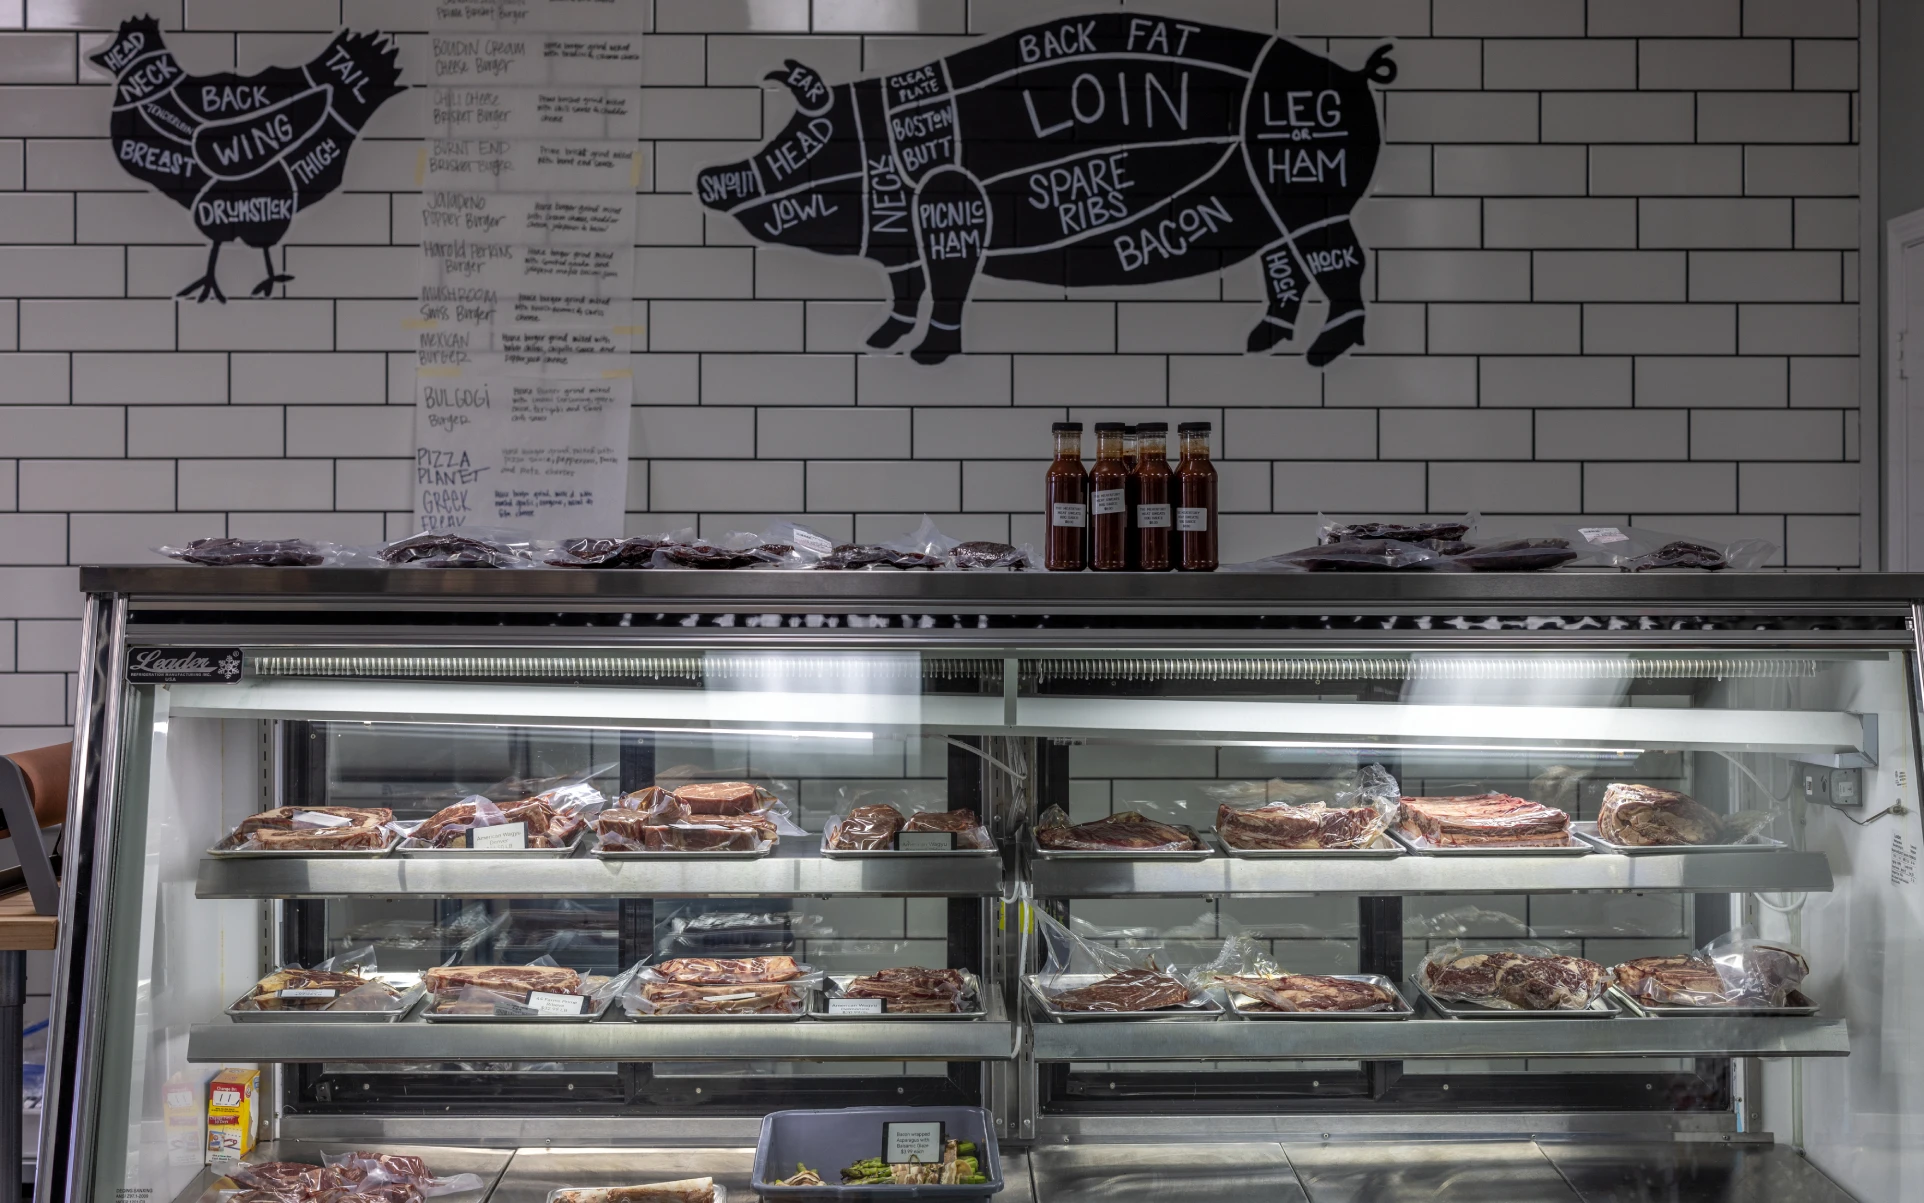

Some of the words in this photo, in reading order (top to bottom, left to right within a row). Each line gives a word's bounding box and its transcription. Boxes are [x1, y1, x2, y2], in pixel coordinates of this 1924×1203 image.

[104, 32, 144, 70] HEAD
[1020, 20, 1096, 62] BACK
[1127, 18, 1200, 55] FAT
[120, 56, 176, 102] NECK
[326, 45, 369, 103] TAIL
[788, 68, 824, 102] EAR
[891, 66, 935, 88] CLEAR
[899, 79, 939, 101] PLATE
[202, 86, 270, 112] BACK
[1023, 72, 1188, 138] LOIN
[1264, 90, 1340, 127] LEG
[213, 114, 293, 165] WING
[892, 105, 953, 141] BOSTON
[1291, 129, 1312, 140] OR
[120, 140, 196, 177] BREAST
[291, 138, 340, 184] THIGH
[479, 140, 510, 155] END
[766, 118, 833, 181] HEAD
[902, 136, 952, 172] BUTT
[1029, 152, 1134, 209] SPARE
[1268, 148, 1346, 187] HAM
[701, 170, 756, 202] SNOUT
[869, 155, 908, 232] NECK
[199, 197, 292, 225] DRUMSTICK
[764, 194, 838, 235] JOWL
[920, 200, 984, 228] PICNIC
[1059, 190, 1128, 234] RIBS
[930, 230, 980, 260] HAM
[1114, 195, 1233, 272] BACON
[1307, 246, 1358, 275] HOCK
[1267, 252, 1299, 308] HOCK
[418, 447, 470, 468] PIZZA
[418, 466, 490, 486] PLANET
[130, 650, 218, 673] Leader
[477, 833, 502, 841] American
